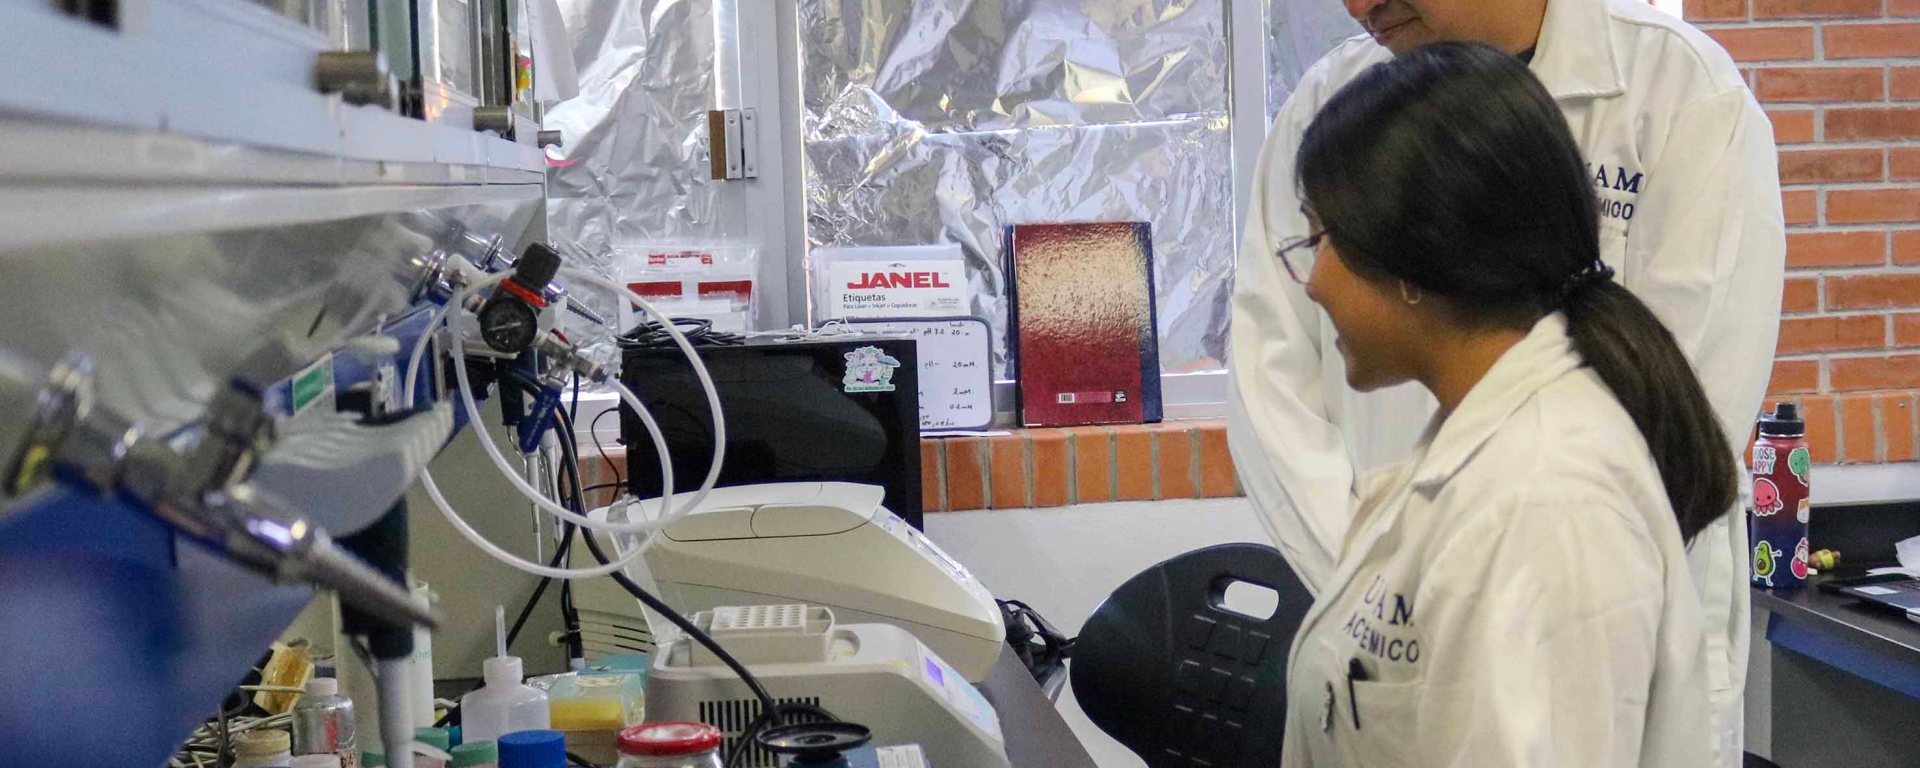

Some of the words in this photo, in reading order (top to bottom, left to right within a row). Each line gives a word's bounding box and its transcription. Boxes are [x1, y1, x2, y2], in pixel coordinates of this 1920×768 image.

[1588, 162, 1644, 194] AM
[847, 272, 950, 289] JANEL
[843, 293, 886, 303] Etiquetas
